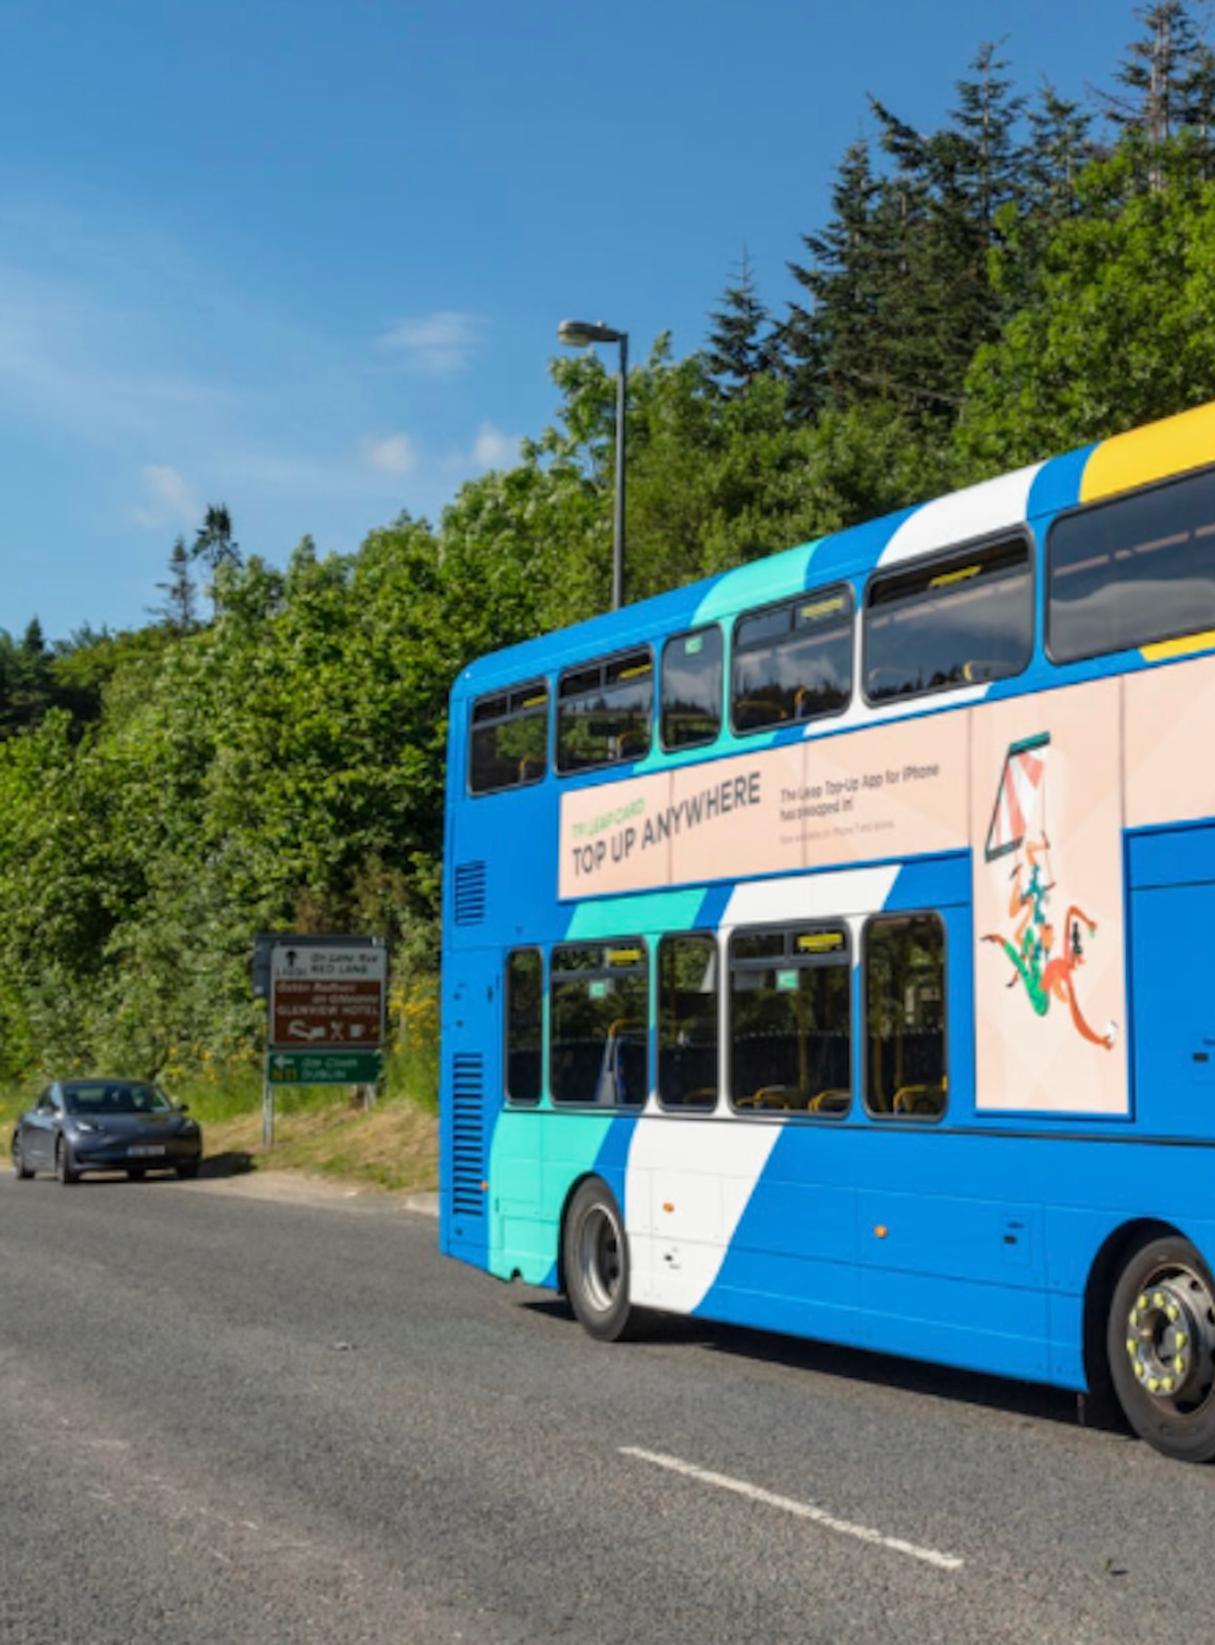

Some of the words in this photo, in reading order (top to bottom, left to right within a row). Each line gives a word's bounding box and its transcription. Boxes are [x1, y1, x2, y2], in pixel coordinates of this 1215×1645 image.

[780, 788, 796, 803] The
[825, 779, 859, 796] Top-Up
[862, 774, 884, 790] App
[886, 769, 900, 785] for
[902, 764, 939, 783] iPhone
[572, 840, 607, 876] TOP
[611, 826, 637, 863] UP
[641, 771, 761, 850] ANYWHERE
